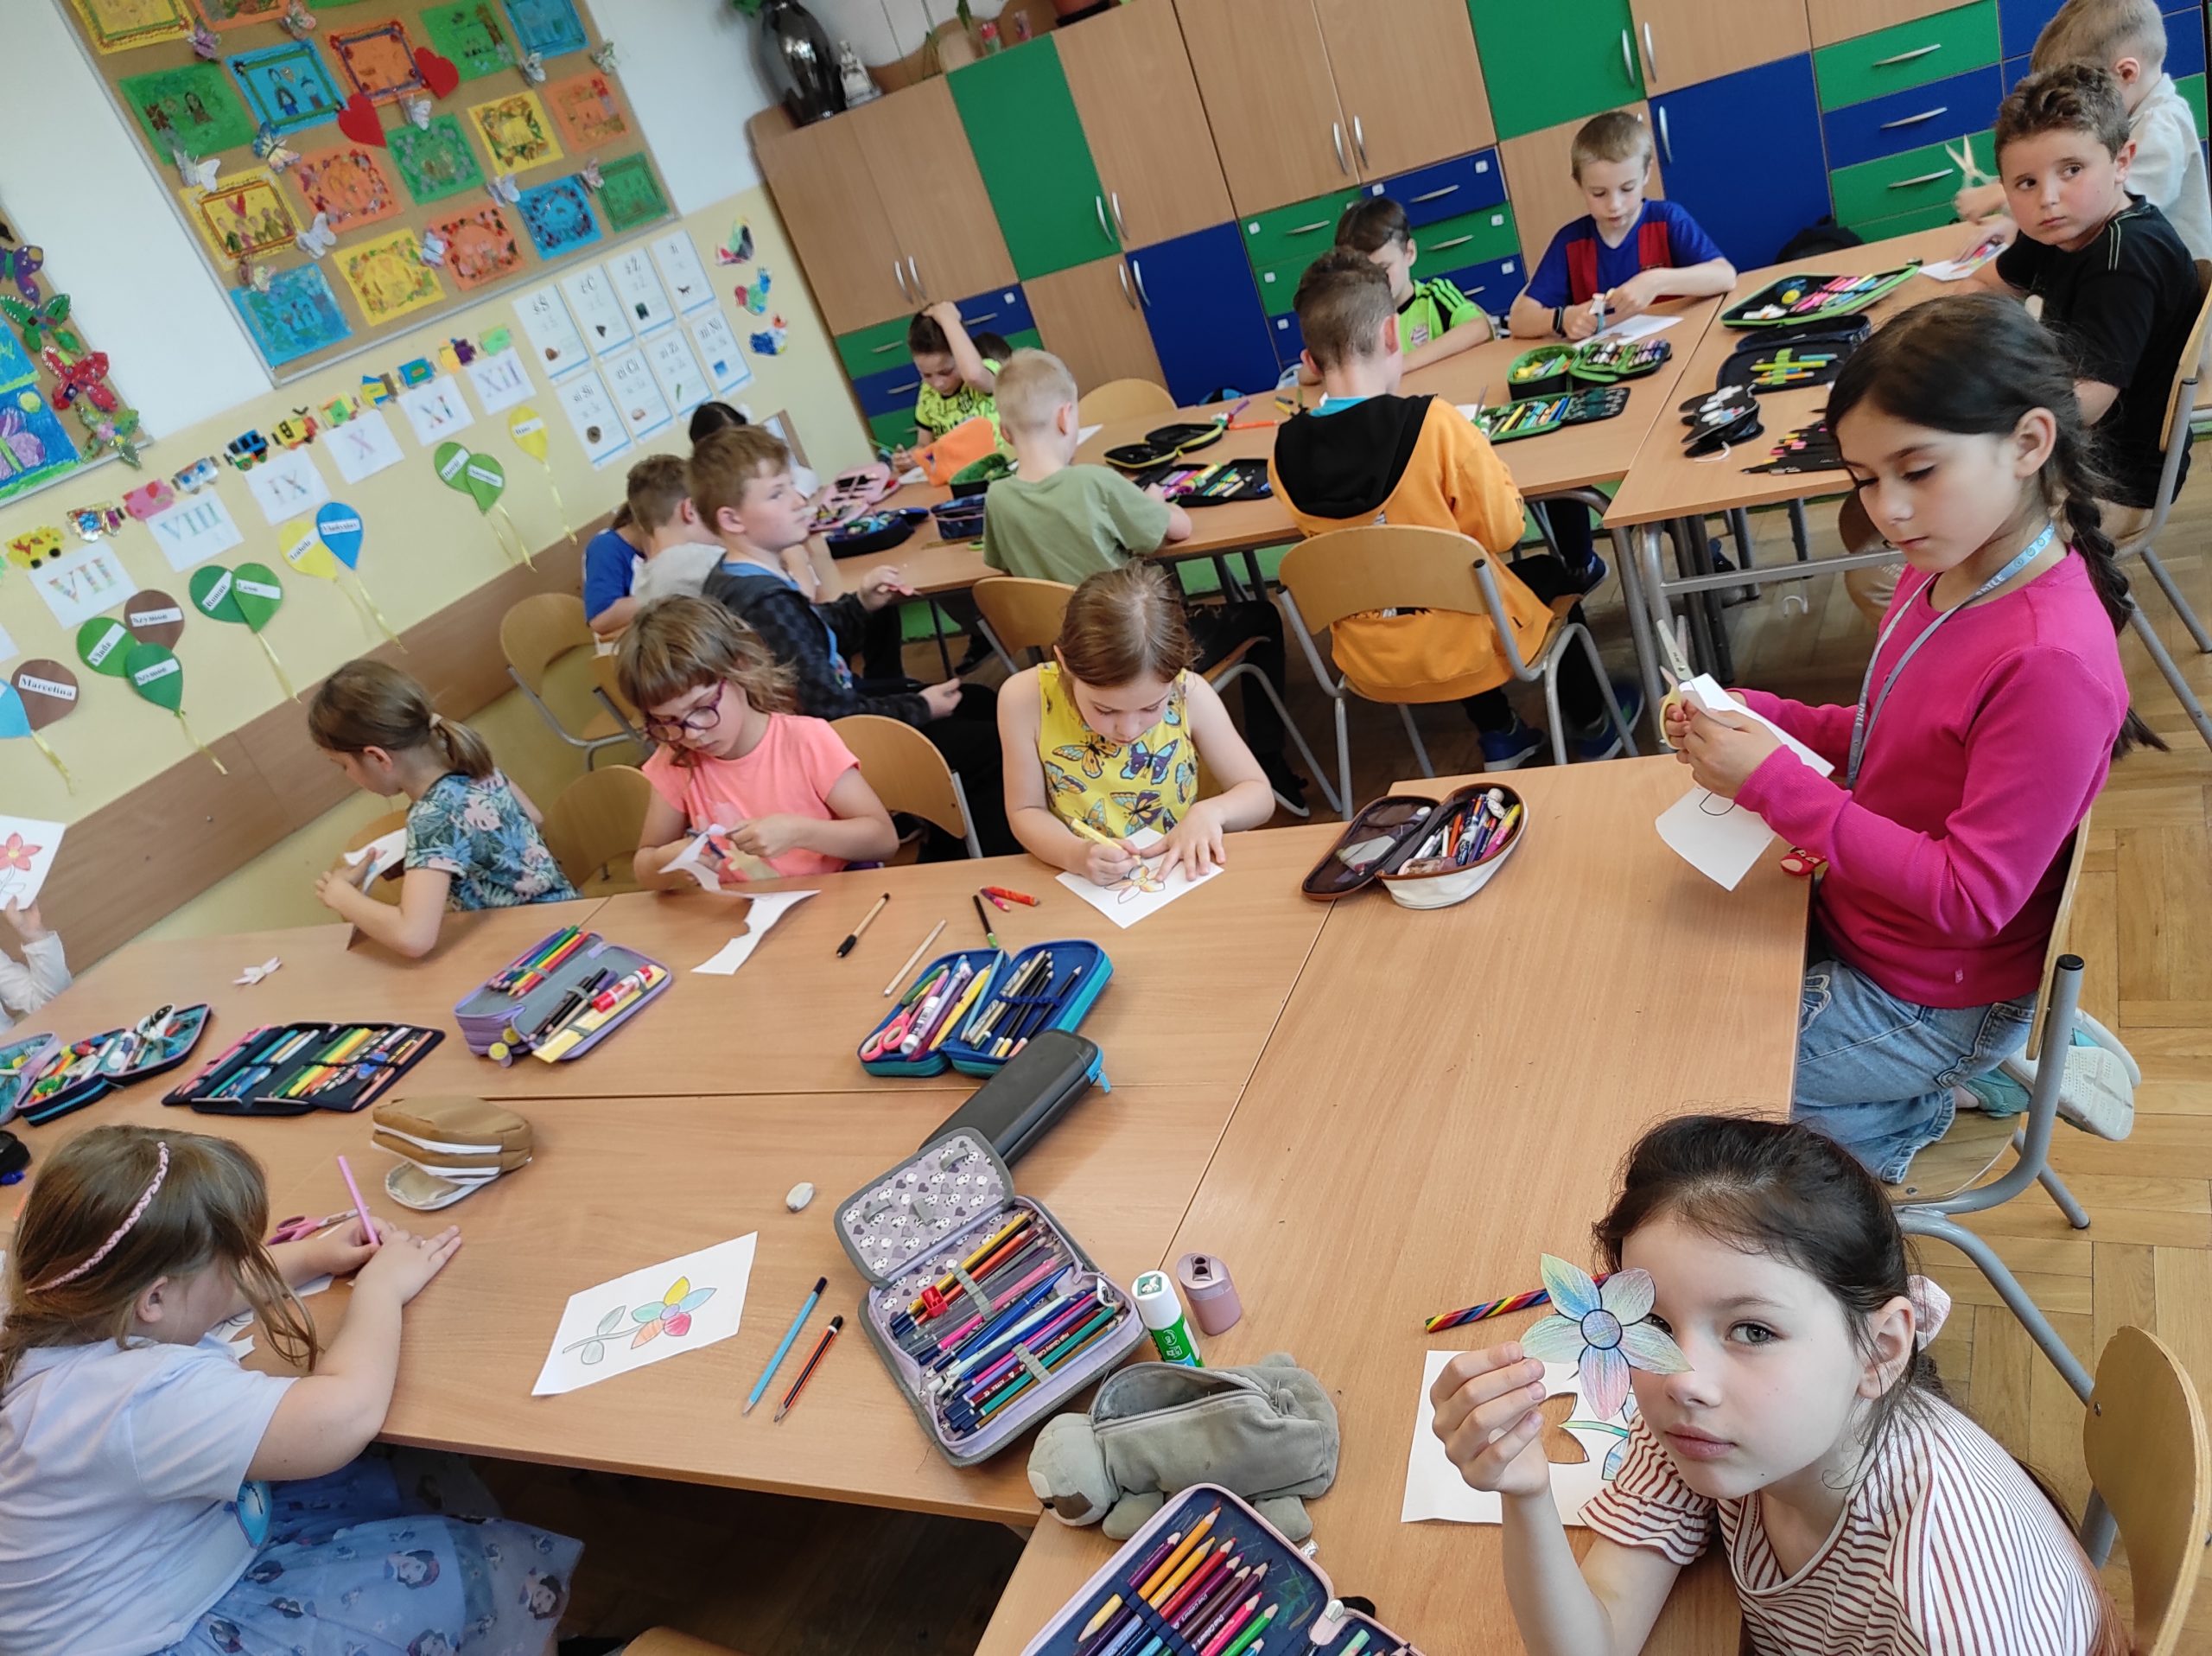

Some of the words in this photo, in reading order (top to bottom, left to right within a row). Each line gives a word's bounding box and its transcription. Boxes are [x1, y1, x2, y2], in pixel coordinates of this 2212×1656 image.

[478, 360, 521, 398] XII
[419, 395, 454, 428] XI
[347, 429, 376, 460] X
[266, 470, 308, 505] IX
[161, 501, 222, 540] VIII
[48, 557, 118, 604] VII
[21, 677, 73, 697] Marcelina
